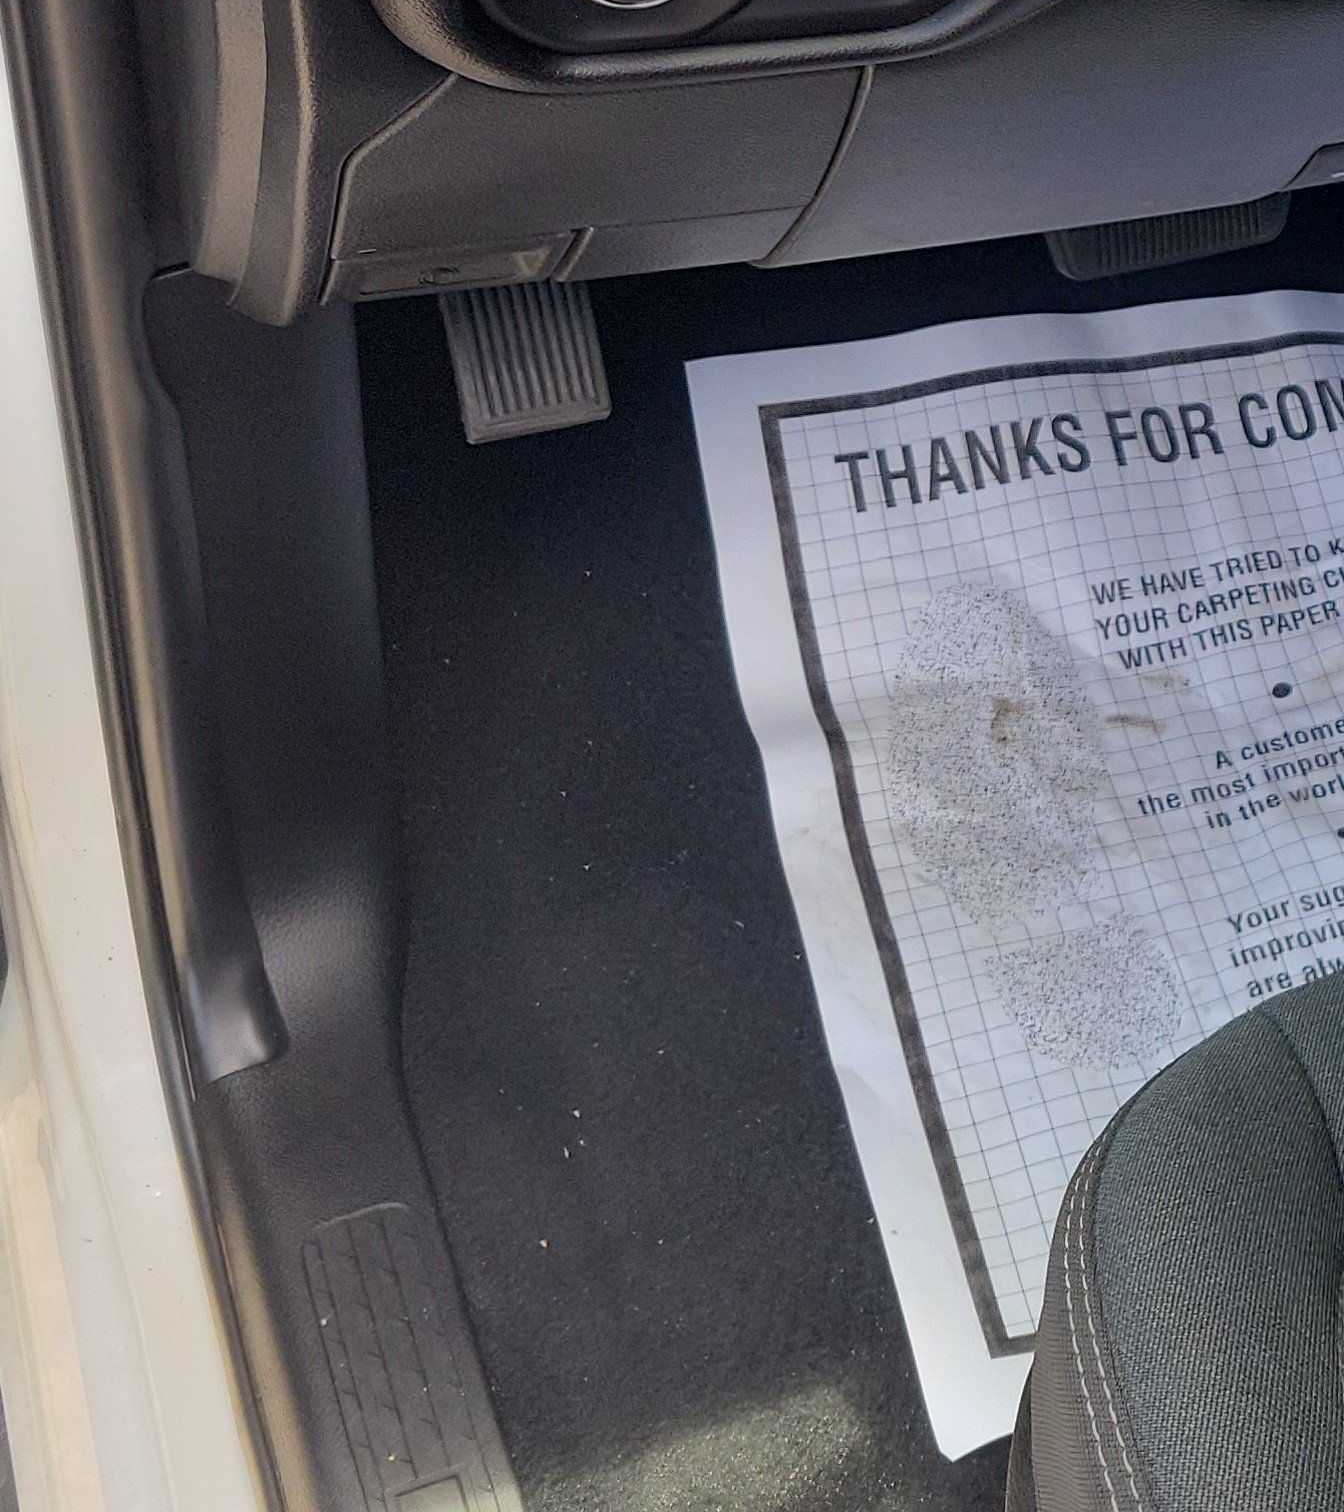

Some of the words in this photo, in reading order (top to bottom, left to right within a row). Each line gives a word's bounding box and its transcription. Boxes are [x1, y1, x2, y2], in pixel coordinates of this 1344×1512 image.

[834, 411, 1092, 513] THANKS
[1106, 401, 1225, 467] FOR
[1091, 577, 1135, 605] WE
[1140, 566, 1204, 596] HAVE
[1210, 549, 1283, 582] TRIED
[1288, 544, 1321, 568] TO
[1094, 606, 1169, 641] YOUR
[1177, 575, 1315, 624] CARPETING
[1118, 636, 1188, 670] WITH
[1194, 618, 1252, 651] THIS
[1260, 600, 1340, 636] PAPER
[1215, 751, 1233, 770] A
[1138, 791, 1182, 817] the
[1191, 772, 1256, 806] most
[1205, 810, 1232, 830] in
[1239, 792, 1282, 822] the
[1226, 899, 1290, 934] Your
[1246, 966, 1293, 998] are
